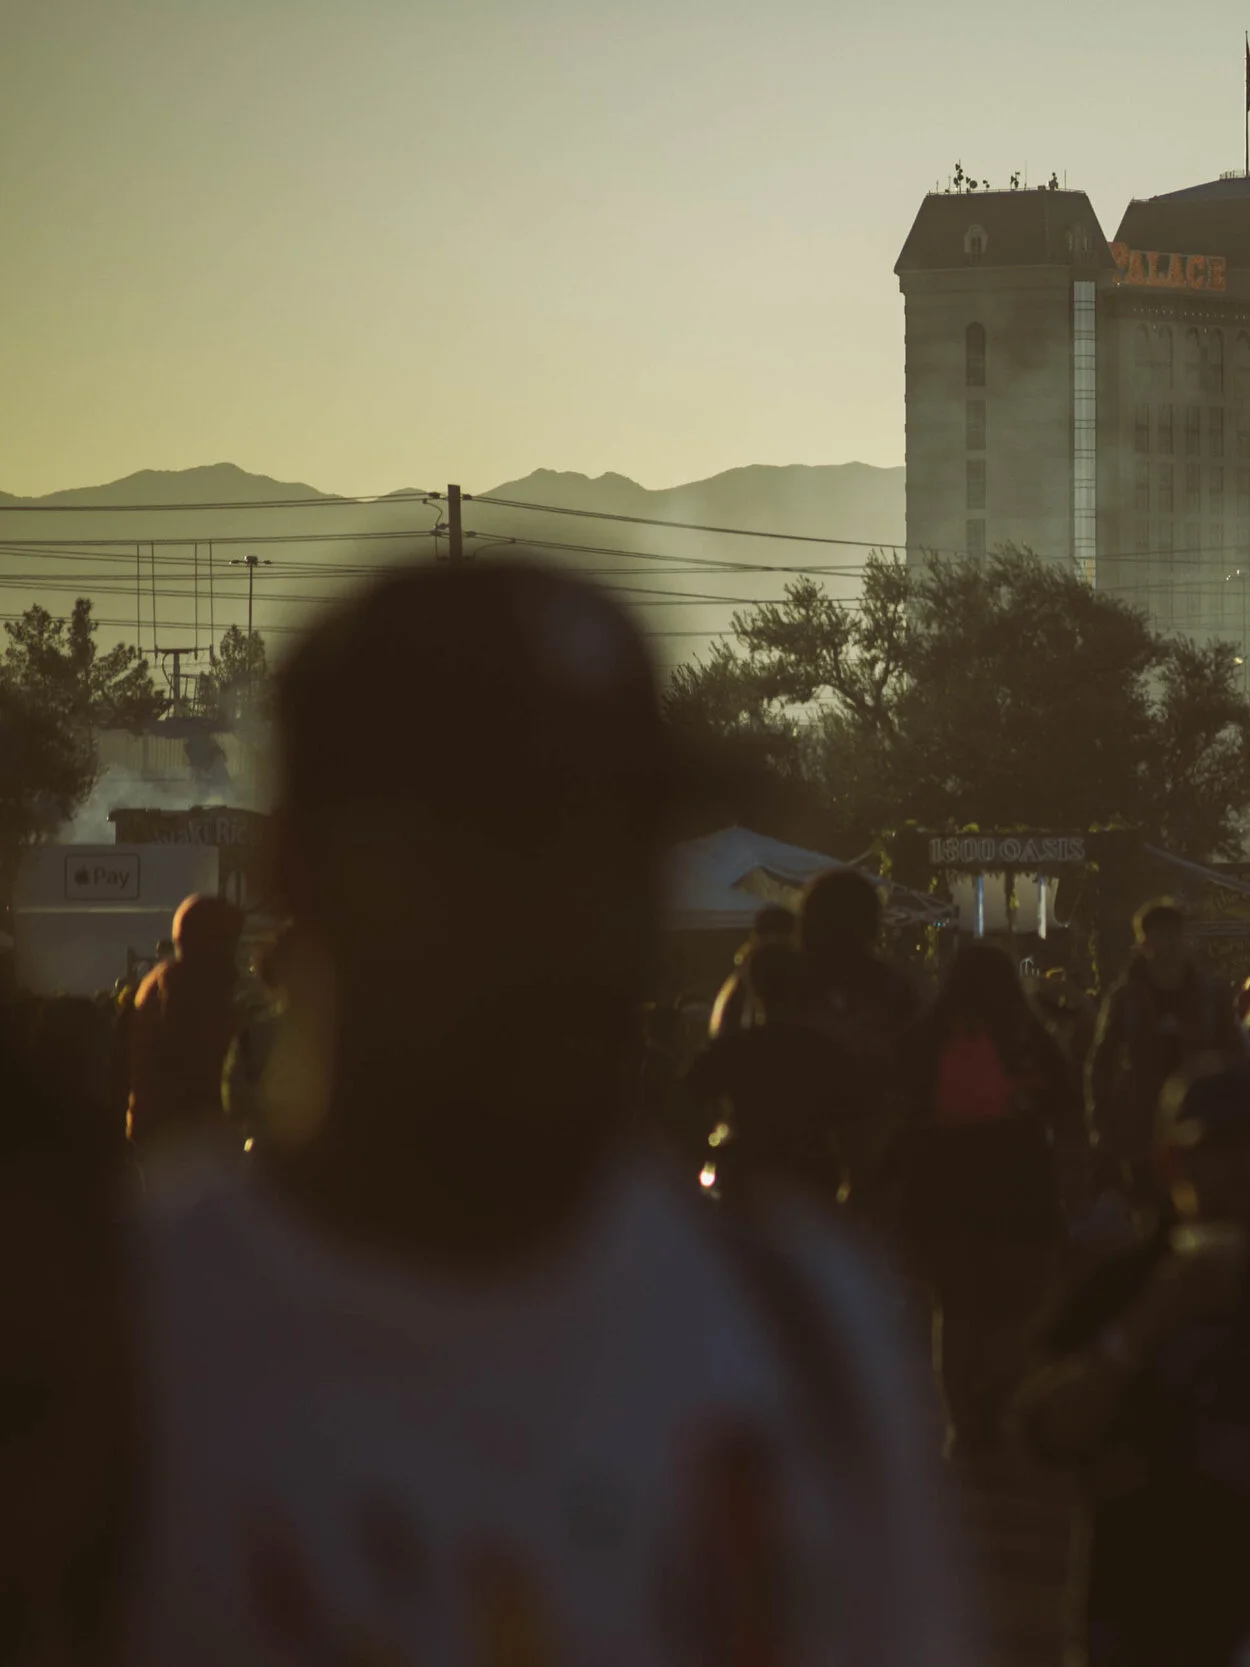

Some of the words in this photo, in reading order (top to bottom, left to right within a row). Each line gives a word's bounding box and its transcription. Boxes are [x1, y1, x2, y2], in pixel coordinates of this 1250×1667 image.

[1108, 242, 1226, 291] PALACE
[1000, 837, 1086, 863] OASIS
[94, 866, 130, 891] Pay
